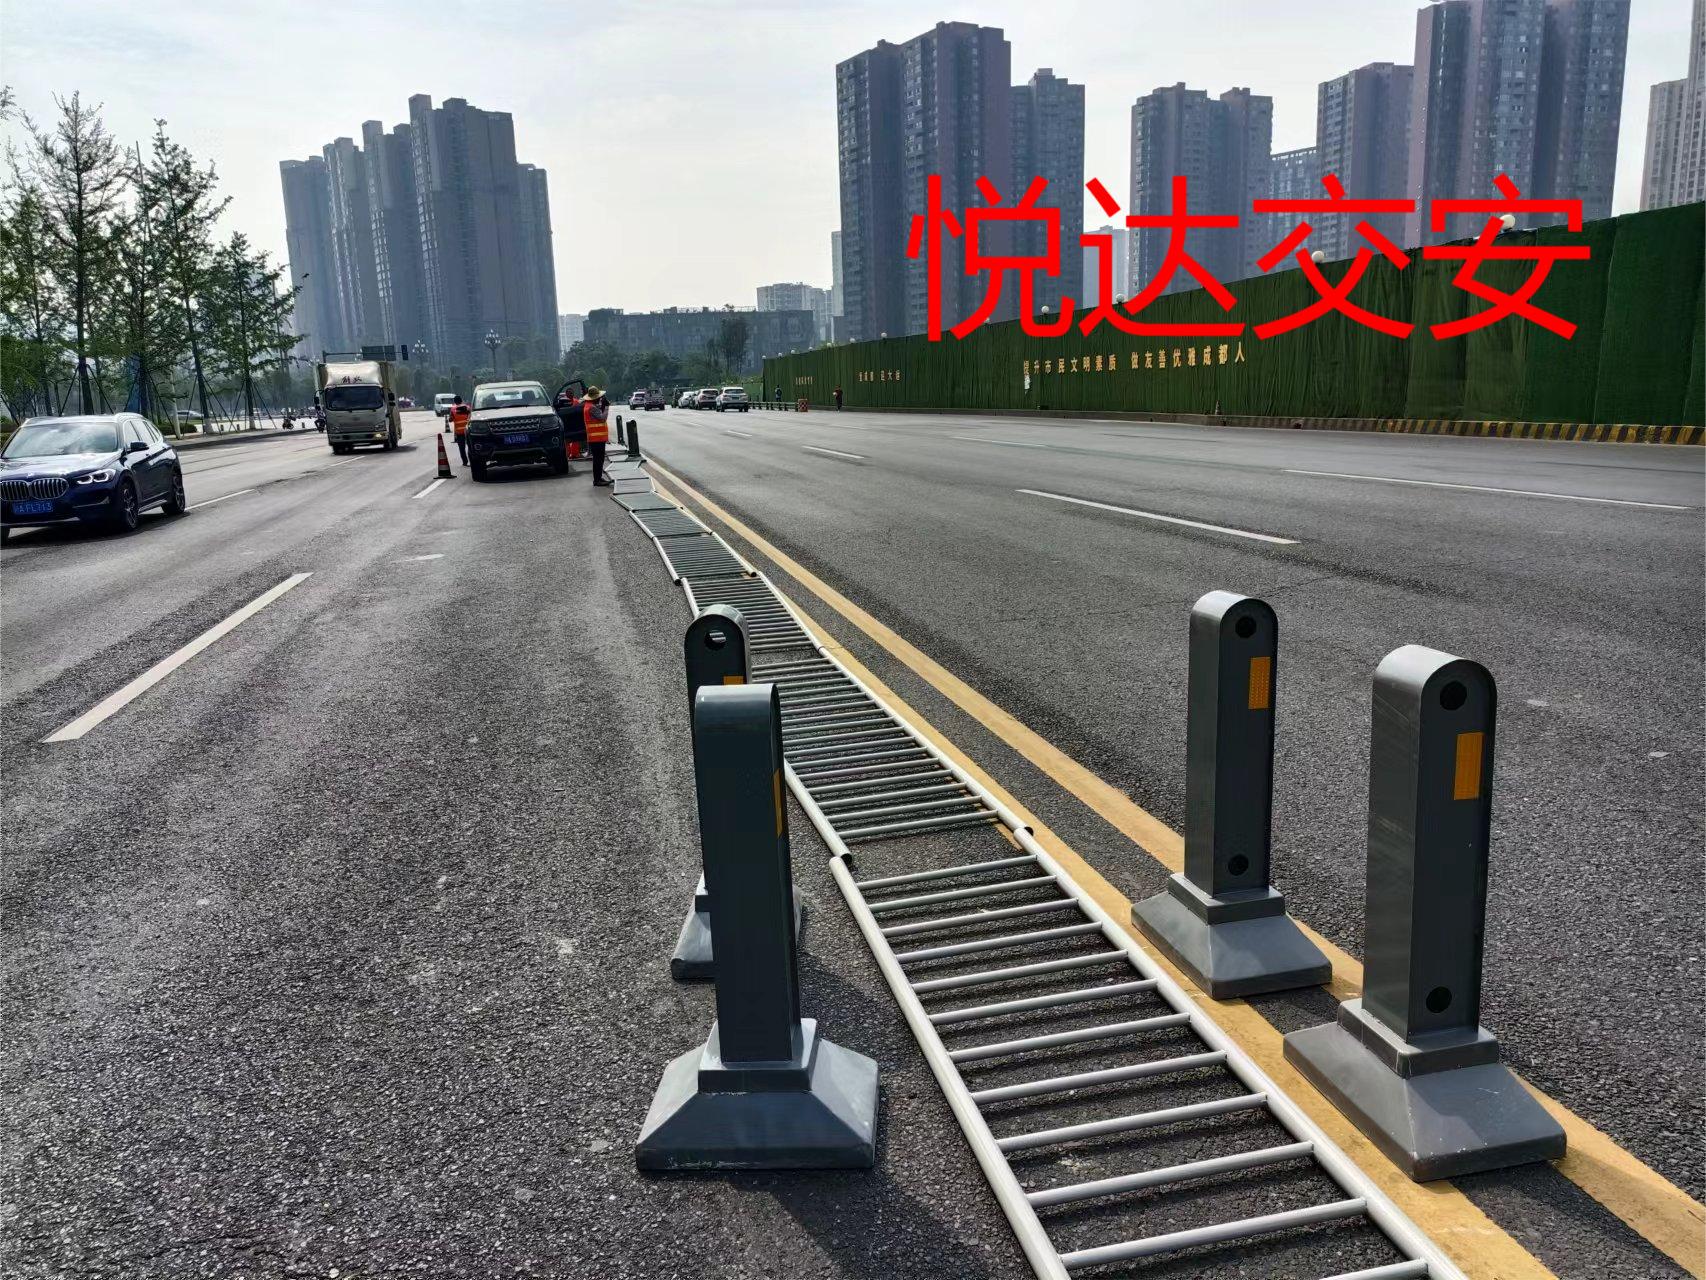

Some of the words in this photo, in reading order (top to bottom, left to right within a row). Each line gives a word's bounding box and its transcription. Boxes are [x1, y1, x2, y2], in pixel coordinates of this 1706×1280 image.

[1130, 341, 1245, 369] 做友善优雅成都人
